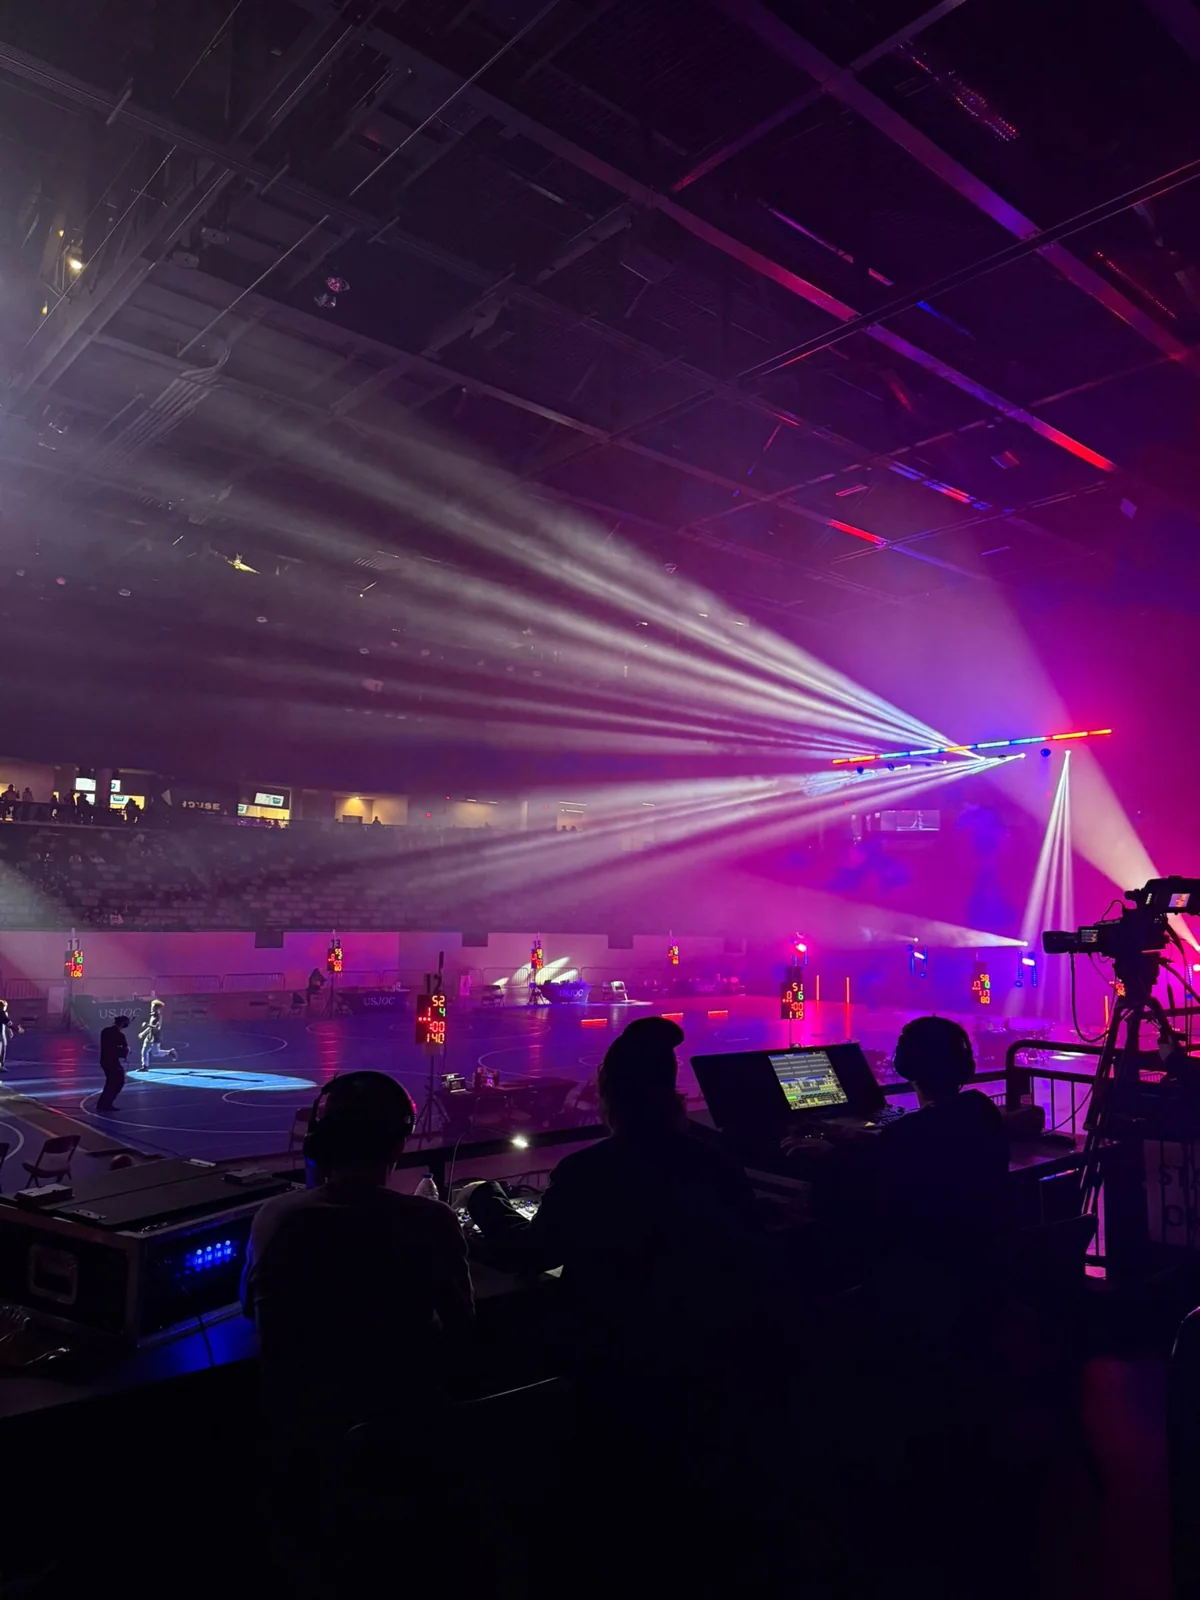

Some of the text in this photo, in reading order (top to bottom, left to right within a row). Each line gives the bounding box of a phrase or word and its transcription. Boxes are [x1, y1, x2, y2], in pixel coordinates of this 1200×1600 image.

[426, 973, 442, 994] 12
[792, 982, 804, 992] 51
[431, 995, 446, 1007] 52
[797, 990, 804, 1001] 6
[438, 1007, 446, 1018] 4
[426, 1032, 445, 1044] 140
